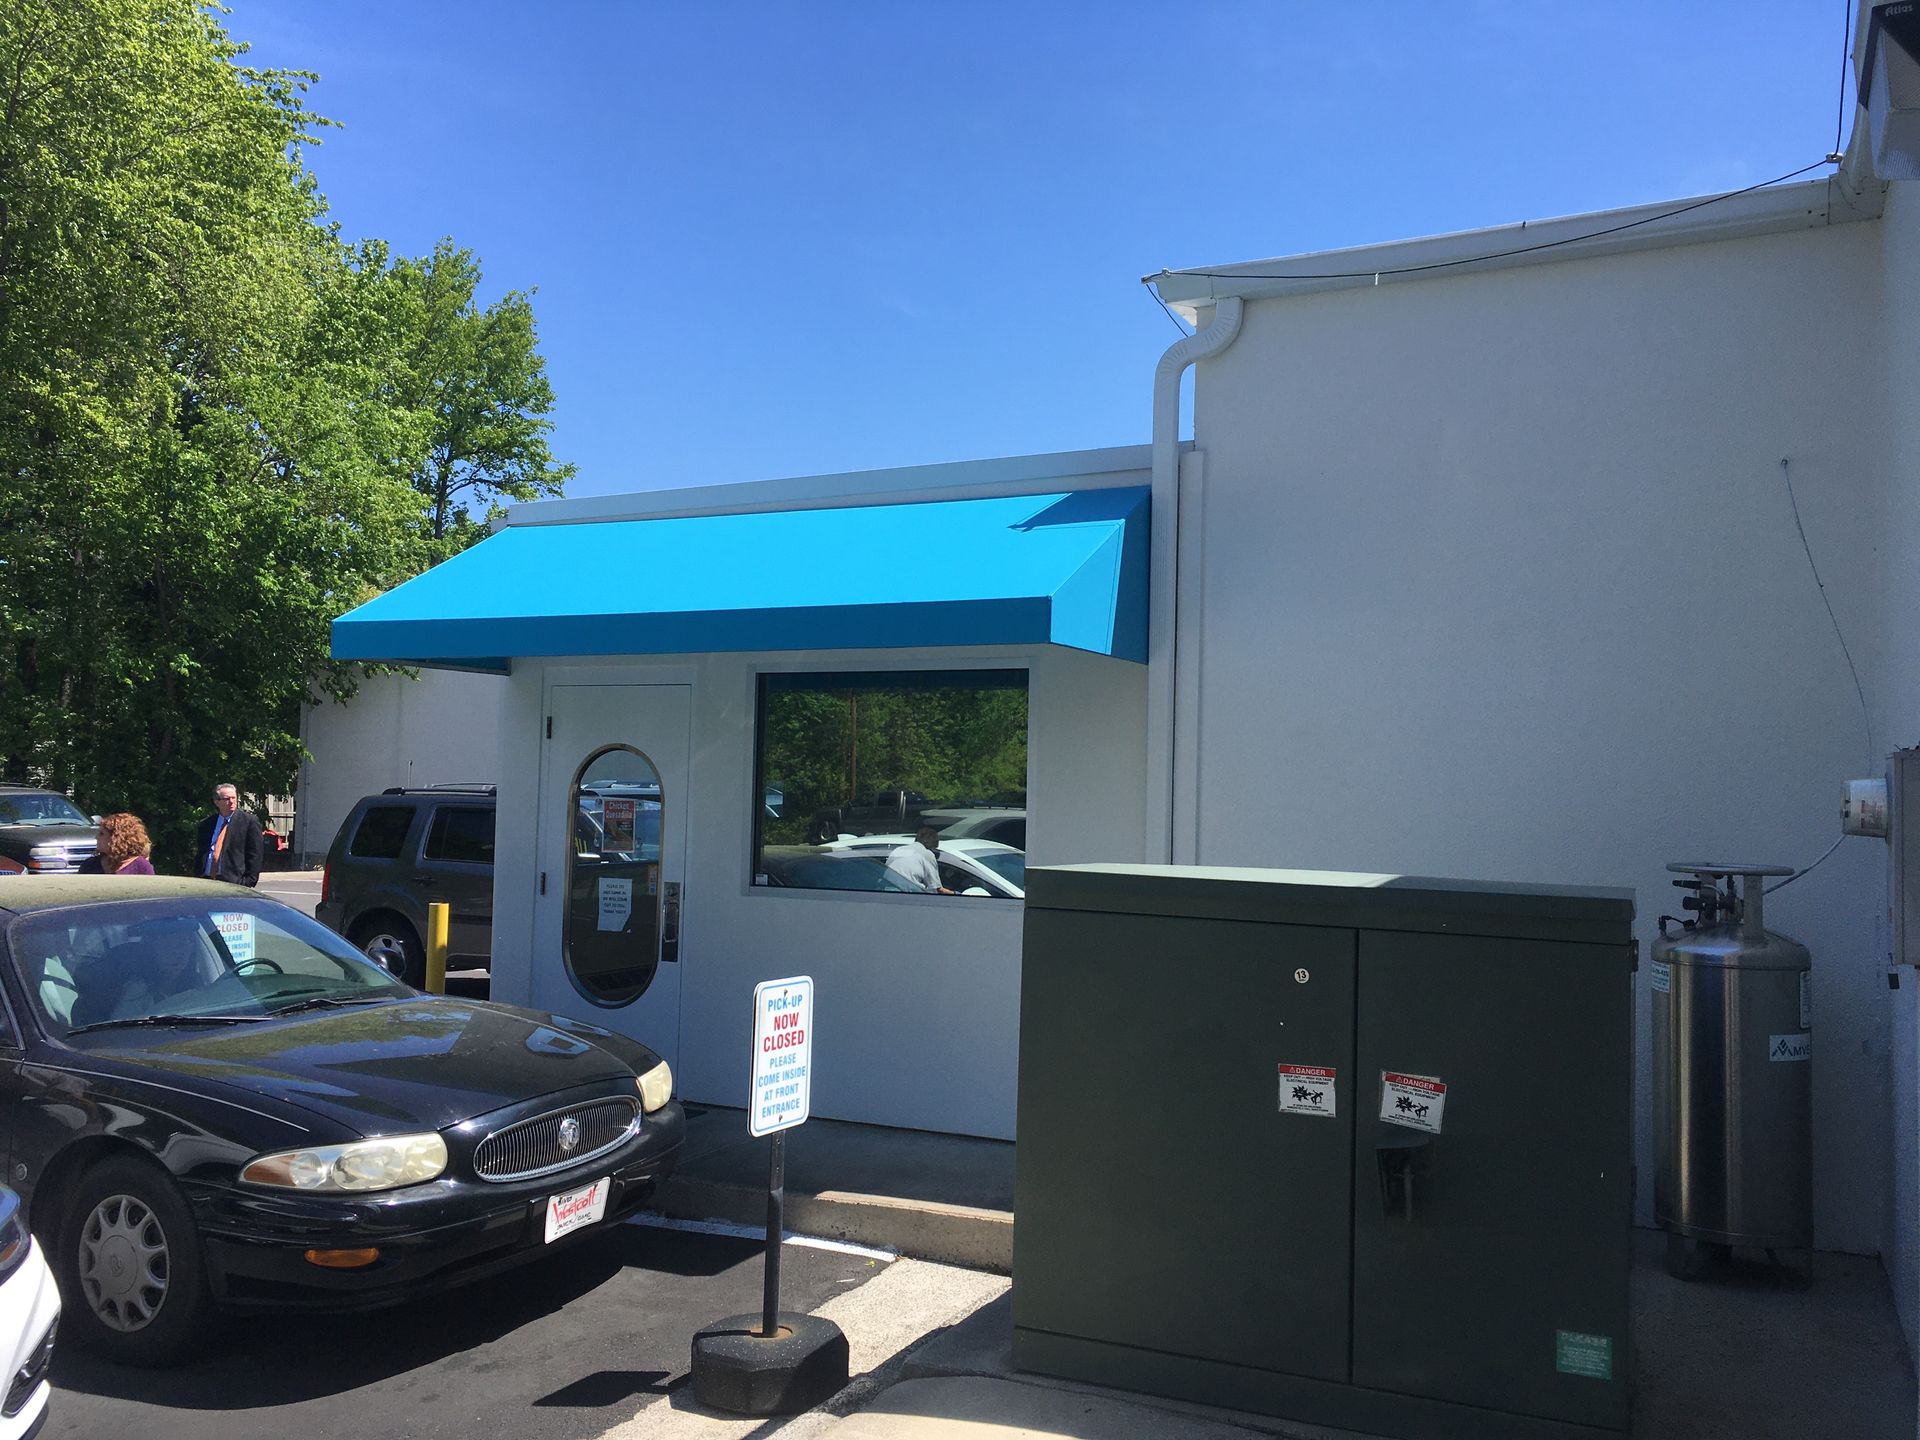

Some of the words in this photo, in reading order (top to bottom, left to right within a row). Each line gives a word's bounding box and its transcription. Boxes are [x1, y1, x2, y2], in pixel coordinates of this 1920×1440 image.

[224, 913, 243, 921] NOW
[1296, 970, 1307, 979] 13
[767, 994, 803, 1012] PICK-UP
[773, 1012, 800, 1031] NOW
[763, 1030, 804, 1052] CLOSED
[769, 1053, 796, 1069] PLEASE
[758, 1072, 780, 1087] COME
[782, 1065, 806, 1082] INSIDE
[1296, 1067, 1326, 1076] DANGER
[764, 1090, 774, 1102] AT
[775, 1083, 799, 1099] FRONT
[1403, 1077, 1435, 1090] DANGER
[762, 1098, 800, 1118] ENTRANCE
